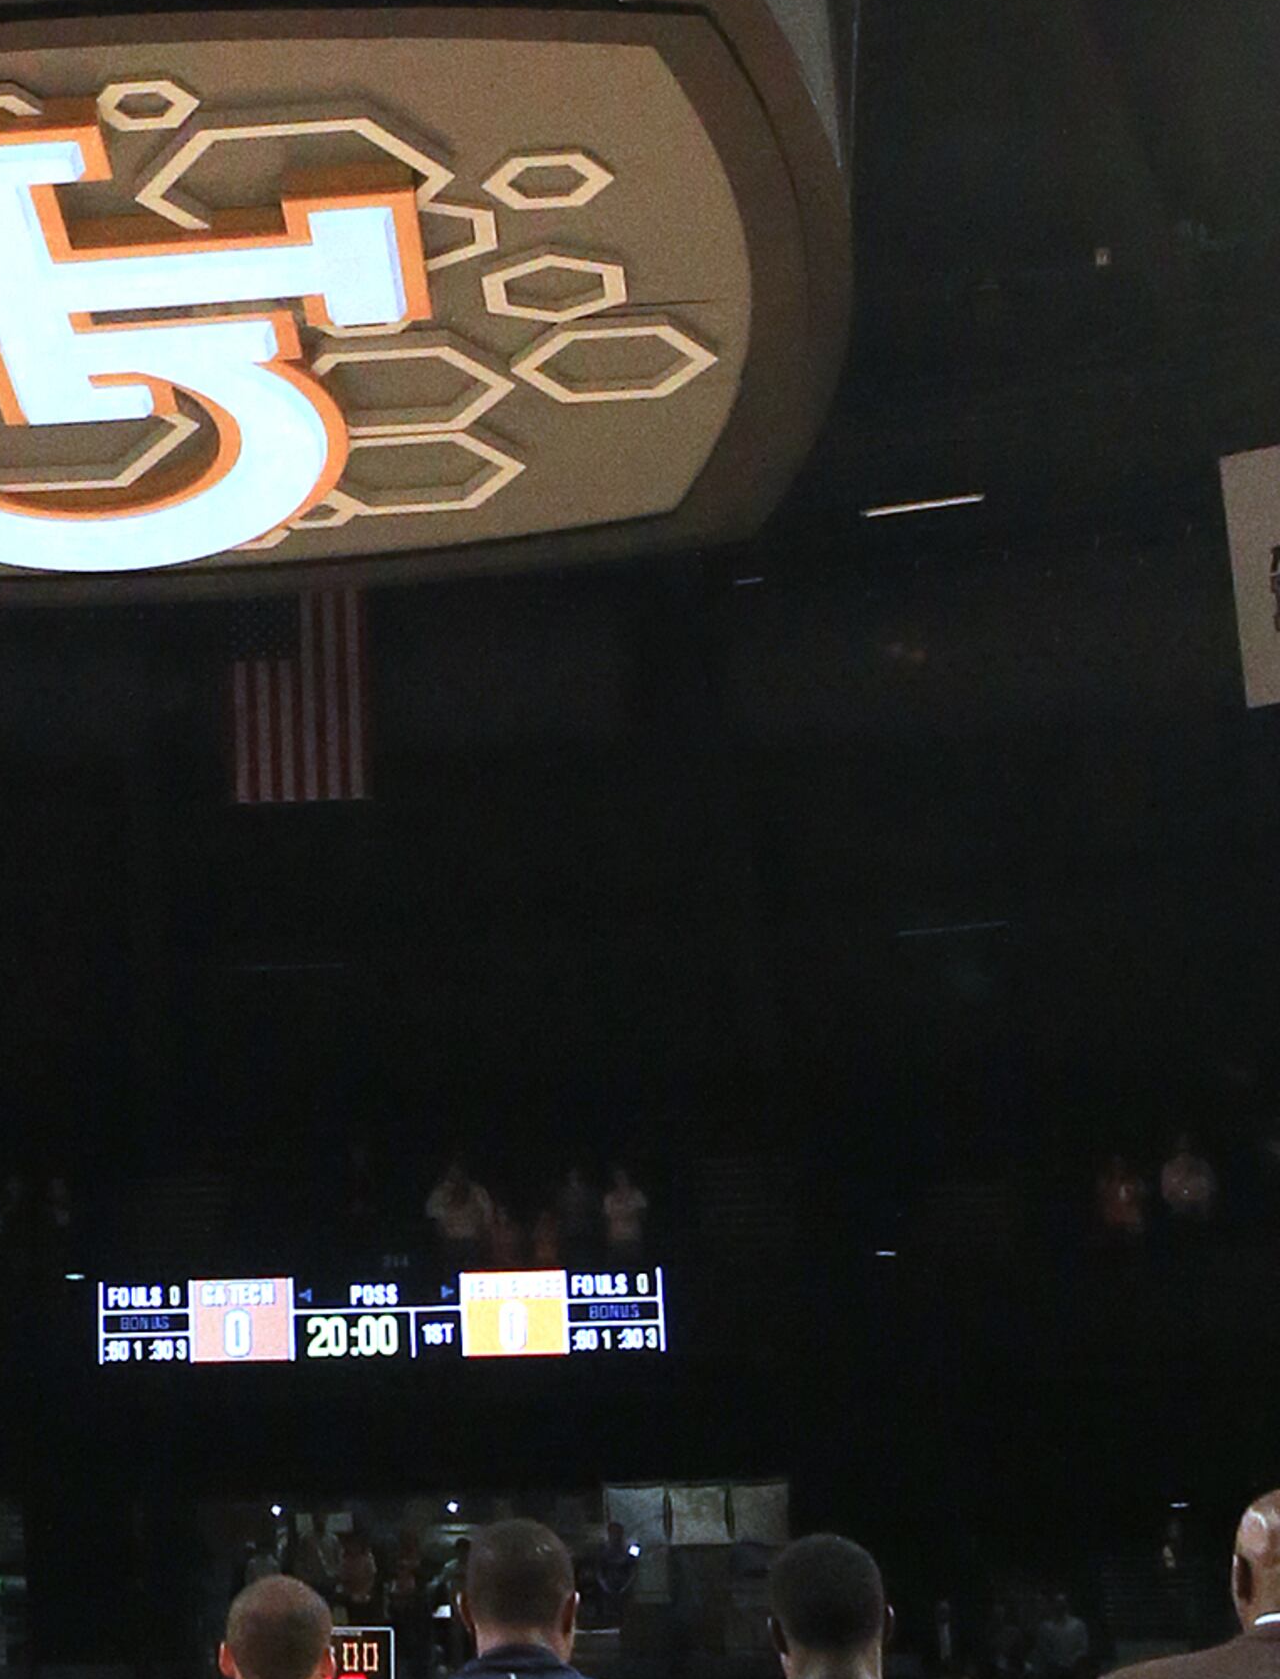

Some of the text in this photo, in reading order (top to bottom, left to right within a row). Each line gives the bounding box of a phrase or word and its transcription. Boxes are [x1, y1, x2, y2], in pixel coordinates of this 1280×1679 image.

[107, 1284, 181, 1308] FOULS 0
[227, 1281, 277, 1306] TECH
[349, 1283, 399, 1306] POSS
[571, 1272, 649, 1296] FOULS 0
[120, 1316, 171, 1331] BONUS
[589, 1303, 641, 1320] BONUS
[224, 1308, 252, 1358] 0
[306, 1314, 400, 1359] 20:00
[421, 1322, 455, 1346] 1ST
[498, 1301, 528, 1351] 0
[133, 1339, 143, 1361] 1
[175, 1338, 188, 1361] 3
[601, 1328, 612, 1351] 1
[645, 1326, 658, 1349] 3
